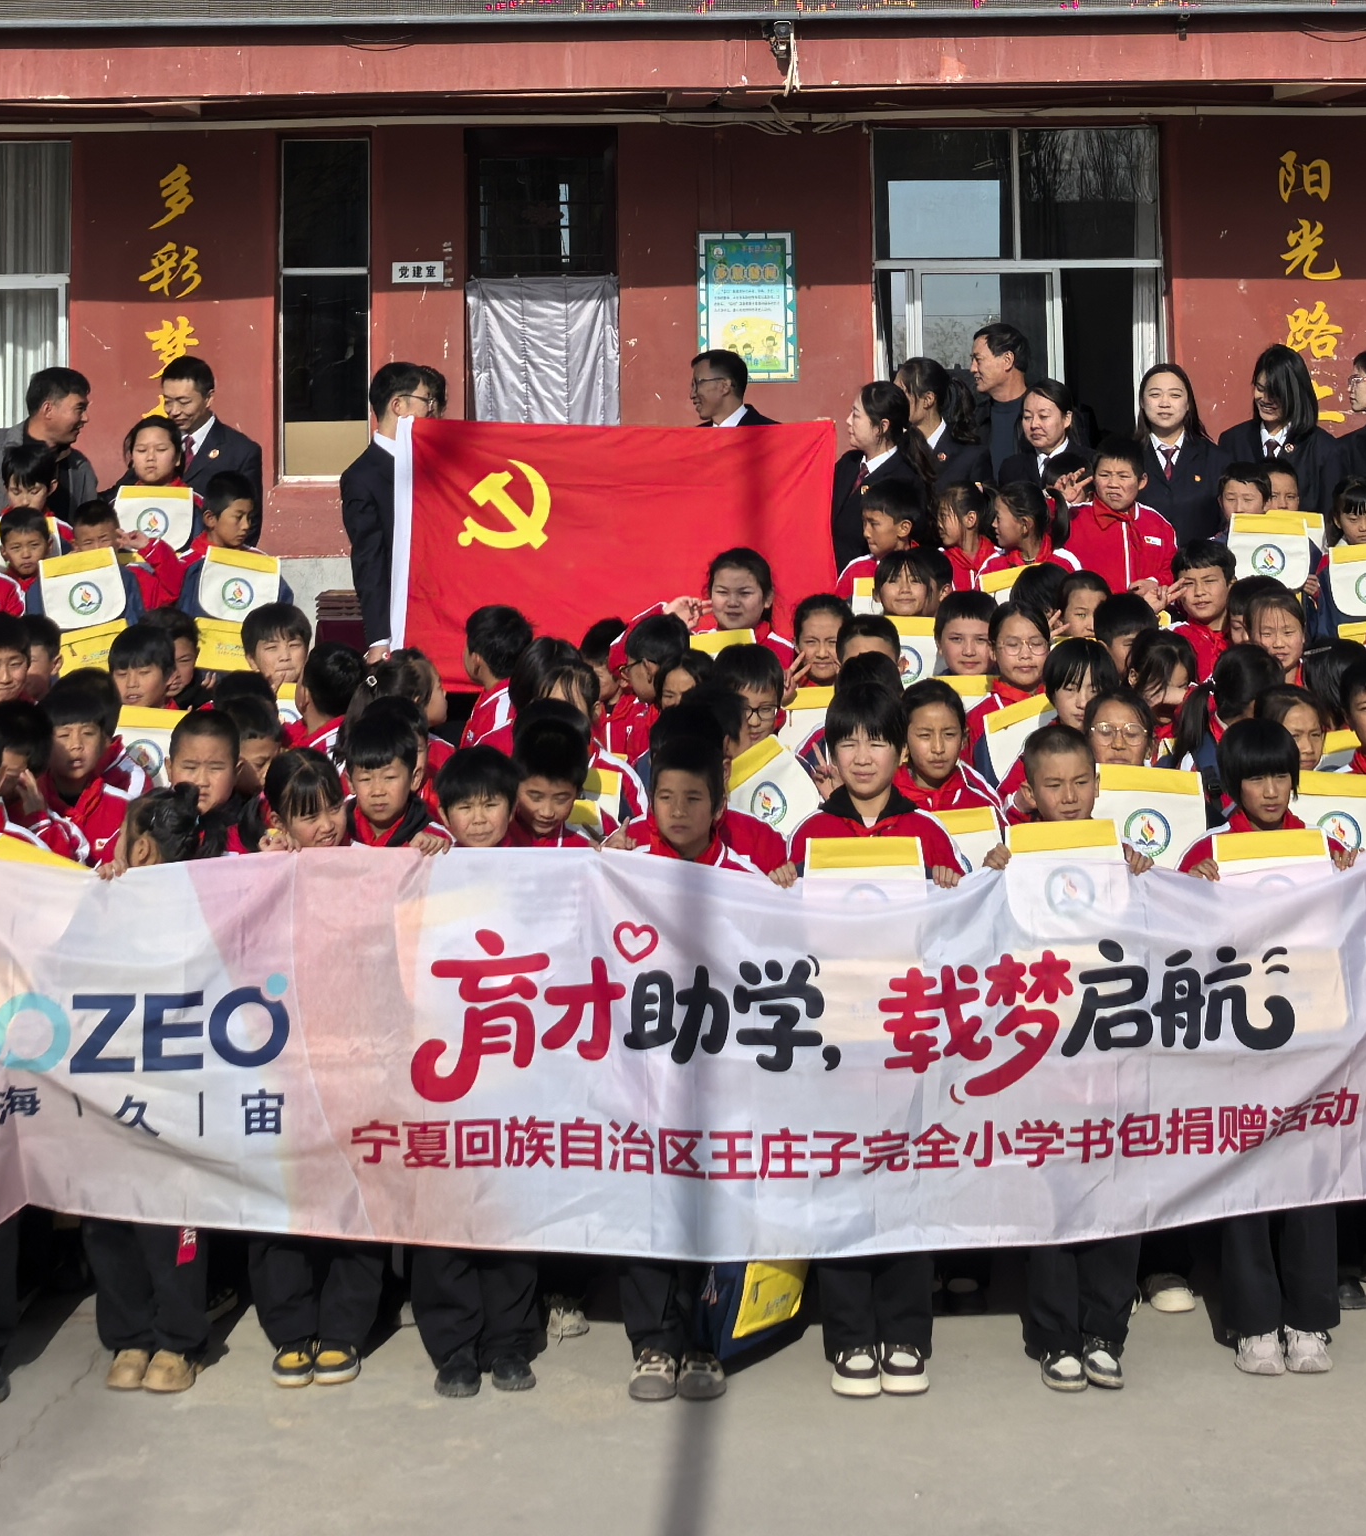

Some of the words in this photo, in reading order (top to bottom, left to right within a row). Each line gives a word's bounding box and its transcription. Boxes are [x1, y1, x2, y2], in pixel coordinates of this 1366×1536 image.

[138, 163, 203, 419] 多彩梦
[398, 265, 437, 278] 党建室
[350, 1085, 1360, 1181] 宁夏回族自治区王庄子完全小学书包捐赠活动
